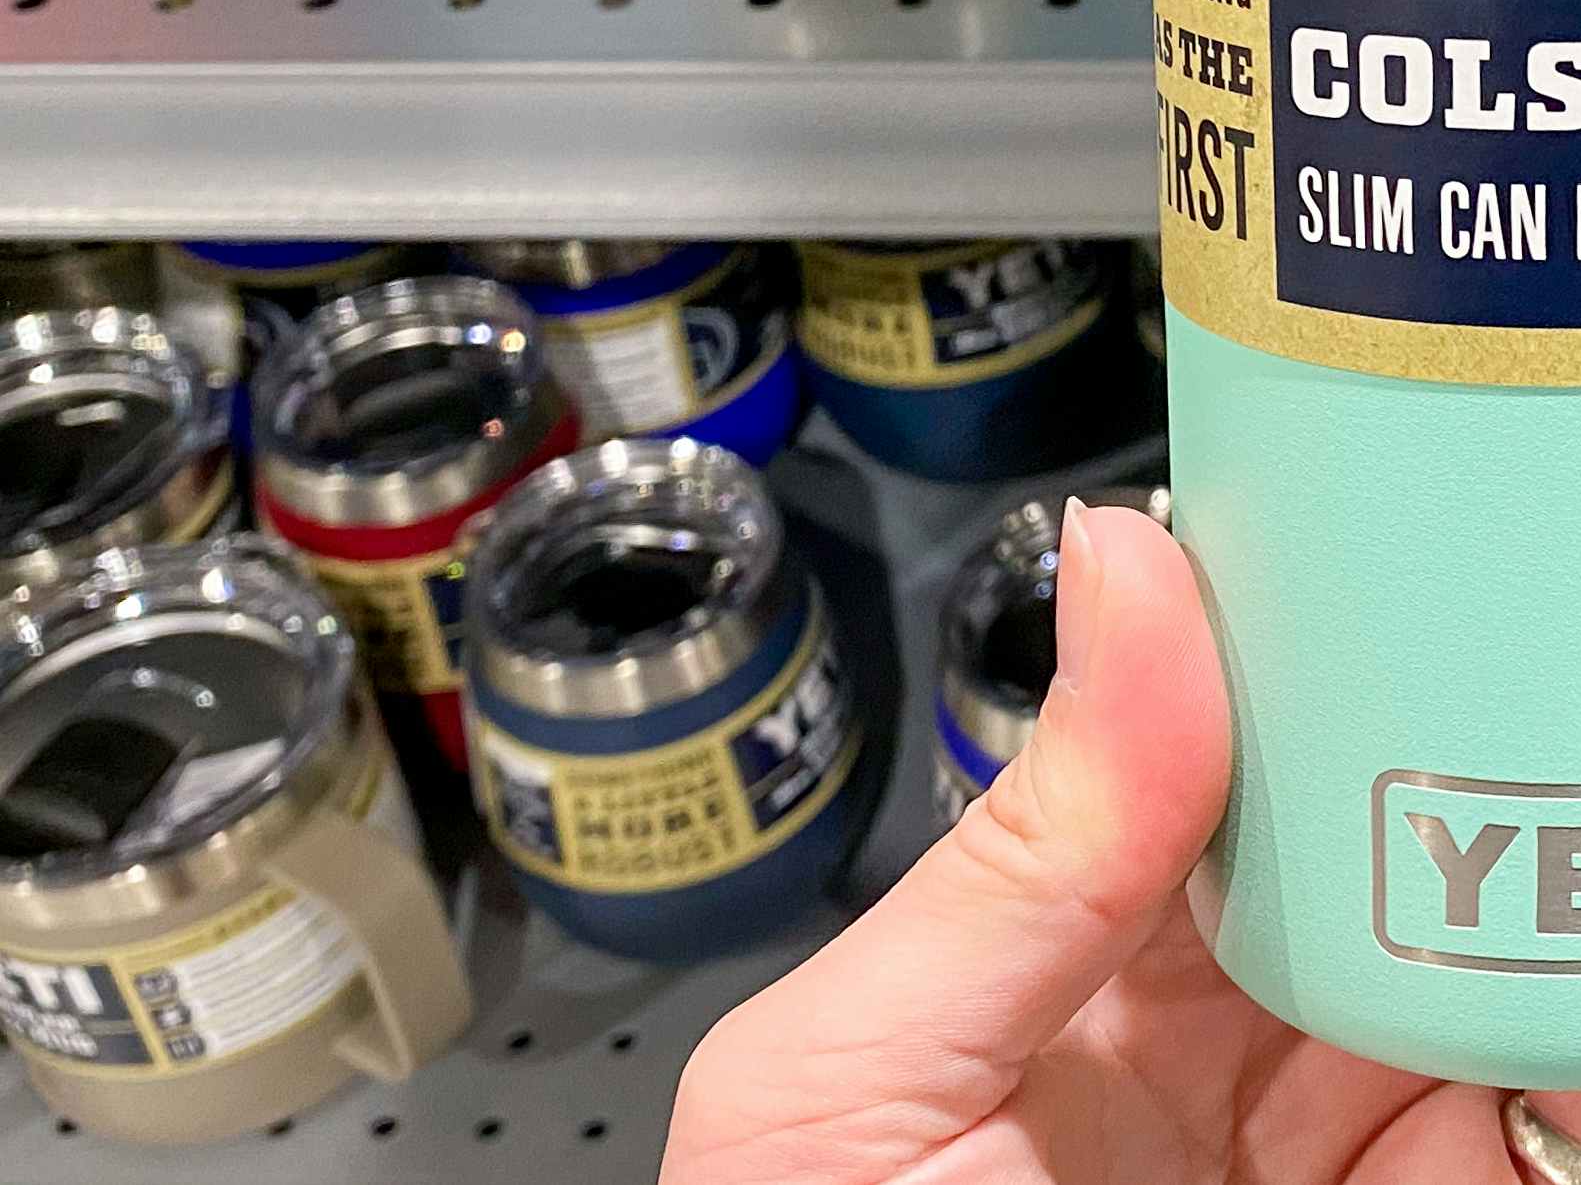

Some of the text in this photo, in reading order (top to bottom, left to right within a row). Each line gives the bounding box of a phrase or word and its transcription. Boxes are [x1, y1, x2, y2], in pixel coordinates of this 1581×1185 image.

[1178, 27, 1253, 96] THE
[1298, 165, 1416, 255] SLIM
[1439, 179, 1547, 261] CAN
